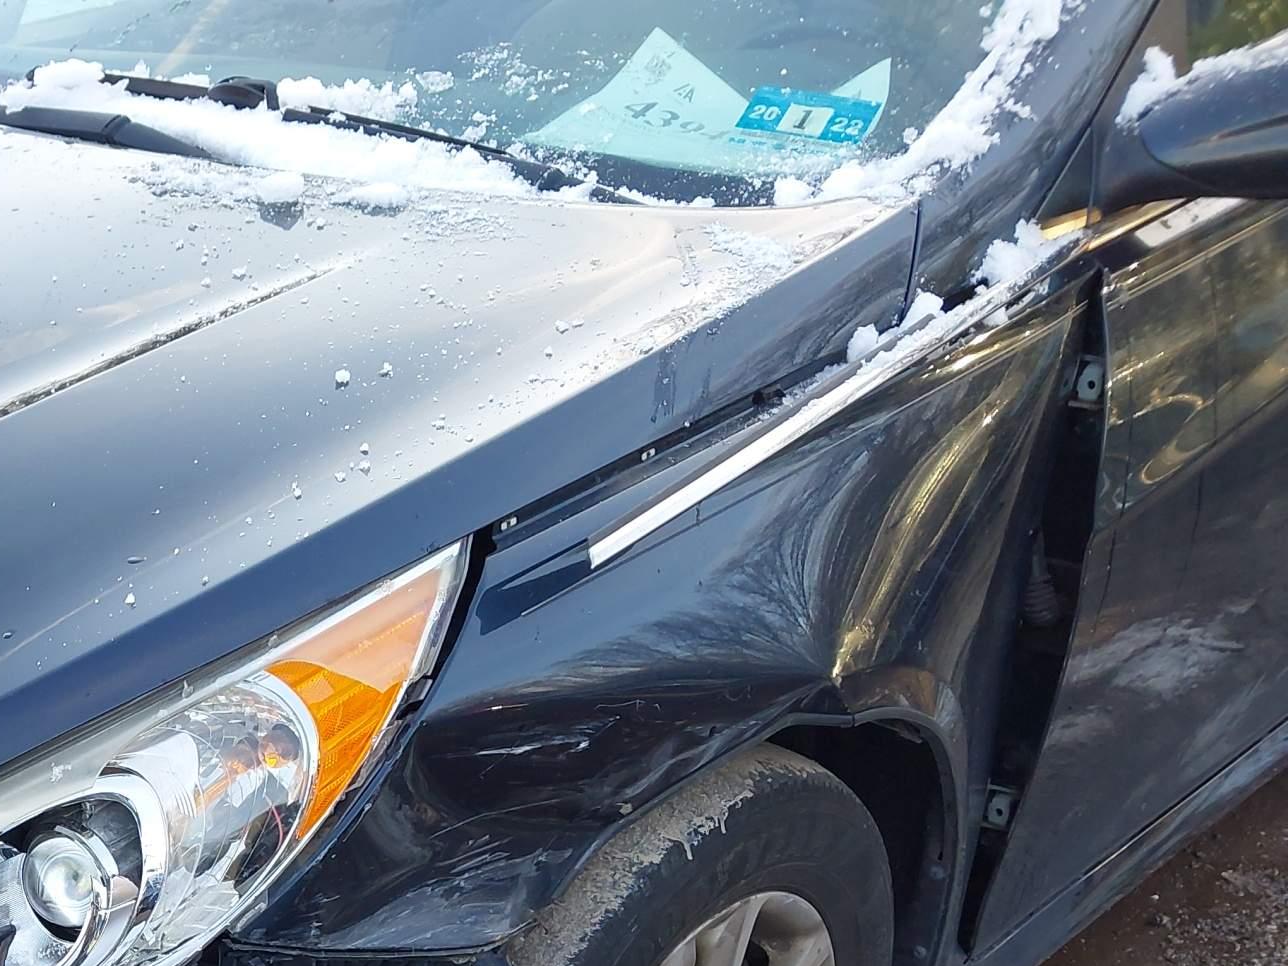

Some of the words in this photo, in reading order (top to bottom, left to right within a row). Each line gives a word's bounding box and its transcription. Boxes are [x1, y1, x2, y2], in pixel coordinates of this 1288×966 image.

[748, 104, 781, 121] 20
[793, 109, 813, 130] 1
[830, 116, 864, 136] 22
